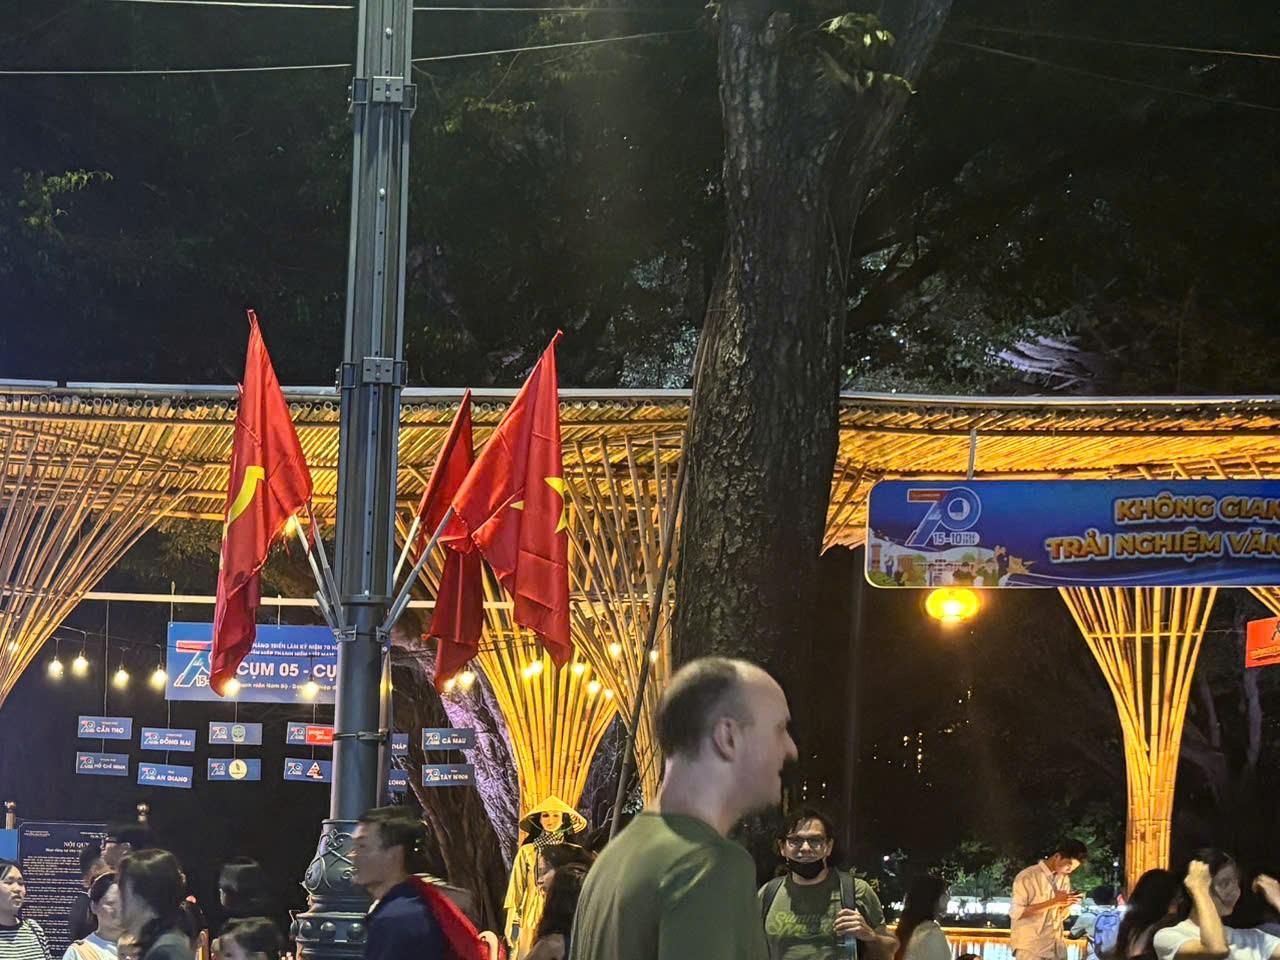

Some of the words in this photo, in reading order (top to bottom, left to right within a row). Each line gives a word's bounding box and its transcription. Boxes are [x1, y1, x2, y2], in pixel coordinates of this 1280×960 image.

[1115, 491, 1216, 525] KHÔNG
[1045, 528, 1112, 564] TRẢI
[1114, 527, 1224, 562] NGHIỆM
[236, 662, 275, 679] CỤM
[279, 663, 299, 677] 05
[313, 664, 337, 681] CỤ
